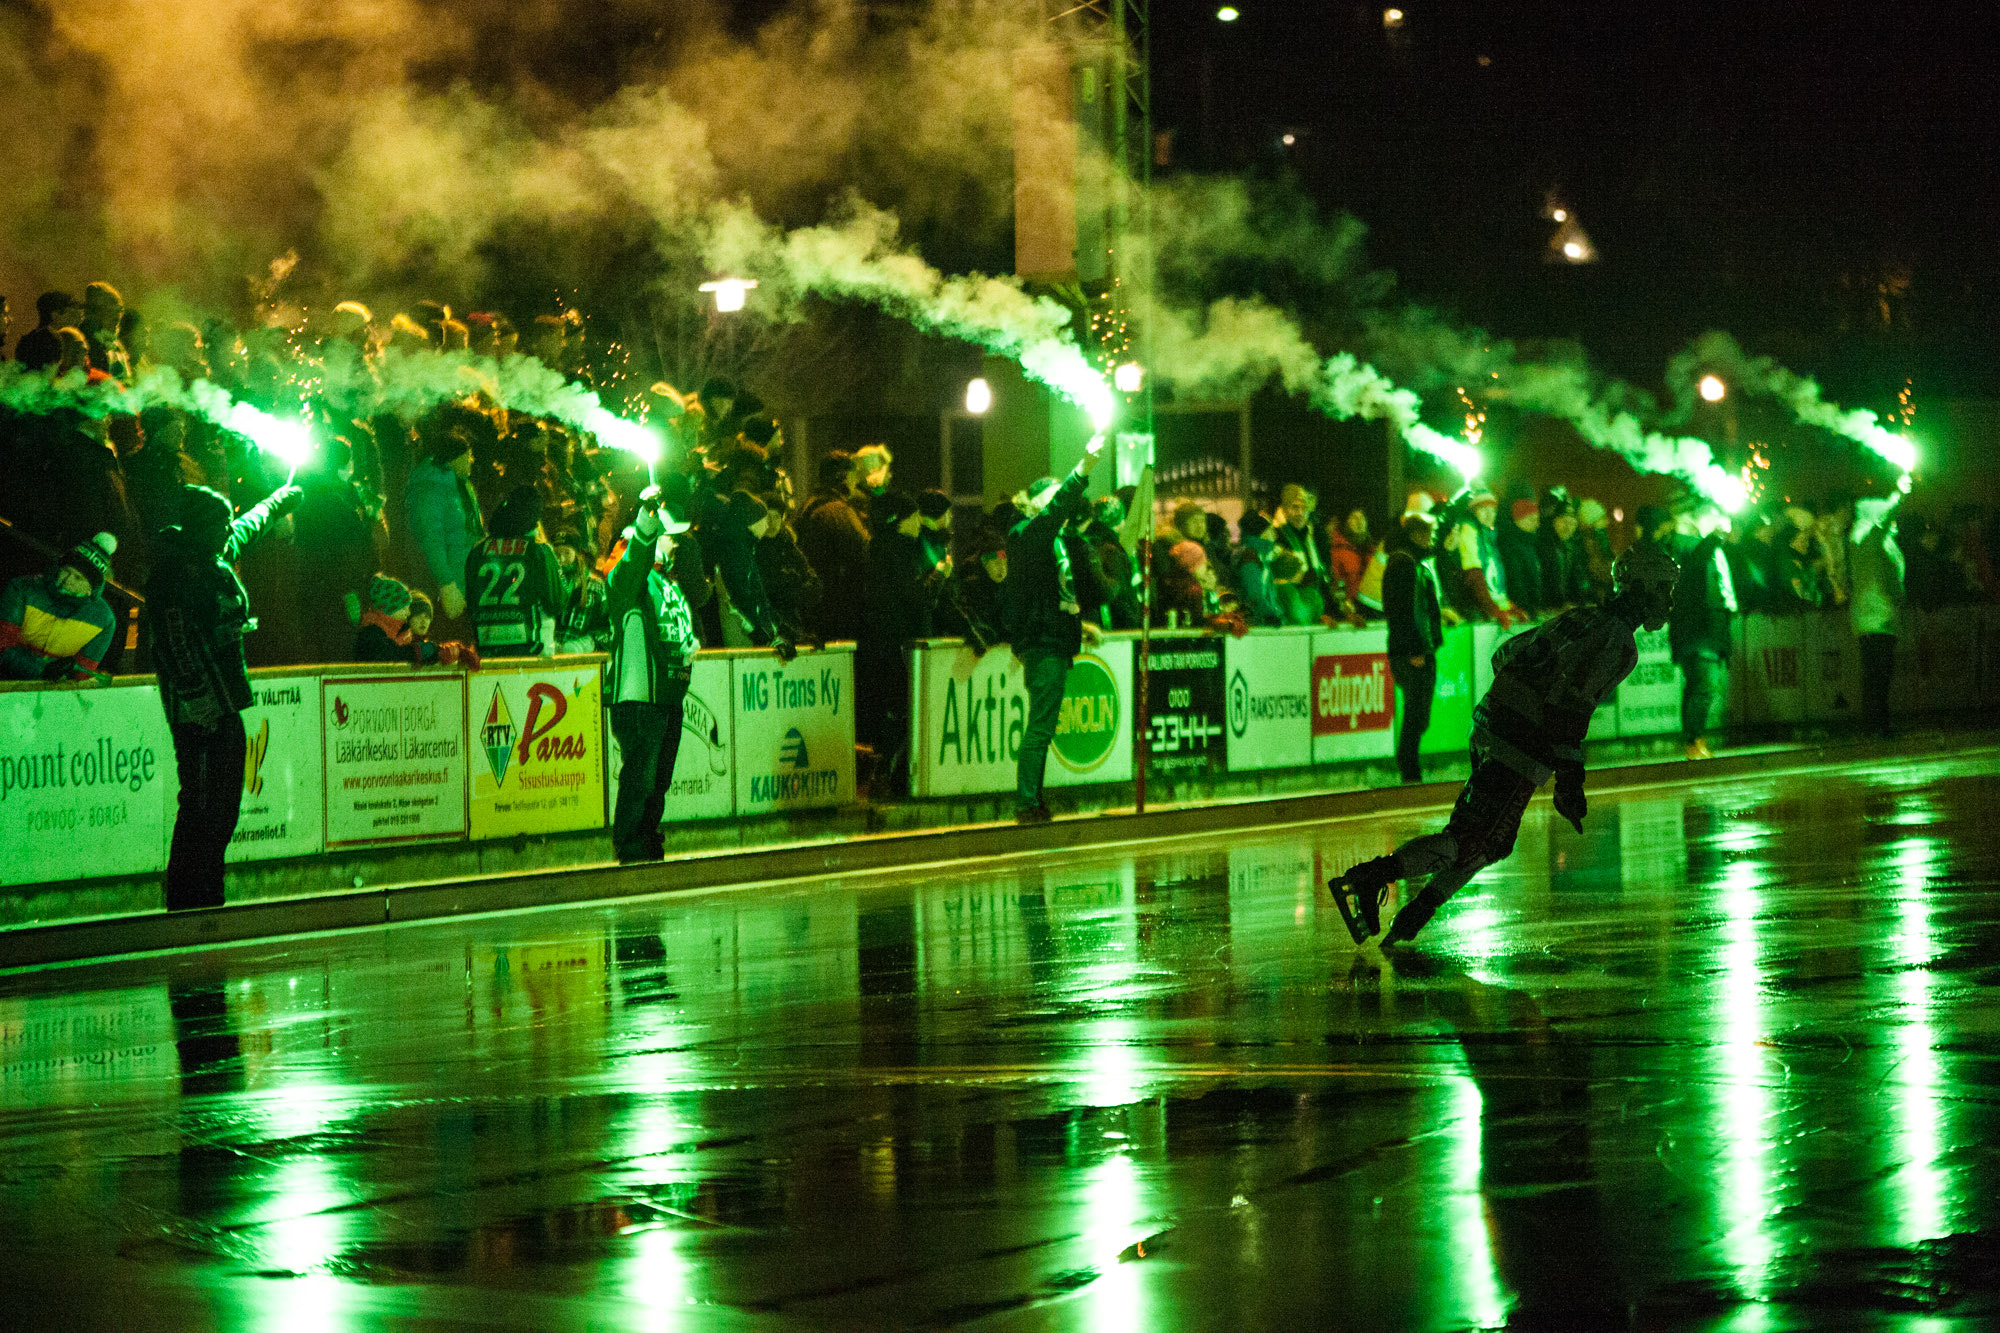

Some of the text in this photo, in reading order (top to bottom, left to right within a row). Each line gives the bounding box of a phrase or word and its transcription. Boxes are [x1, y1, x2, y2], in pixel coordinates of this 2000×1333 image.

[478, 562, 526, 606] 22
[262, 687, 301, 706] VÄLITTÄÄ
[743, 668, 841, 715] MG Trans Ky
[1318, 661, 1385, 728] edupoli
[487, 724, 511, 747] RTV
[518, 683, 586, 766] Paras
[938, 674, 1025, 765] Aktia
[0, 737, 155, 801] point college
[518, 769, 586, 792] Sisustuskauppa
[750, 770, 838, 802] KAUKOKIITO
[27, 808, 76, 832] PORVOO
[231, 823, 287, 844] uokraneliot.fi
